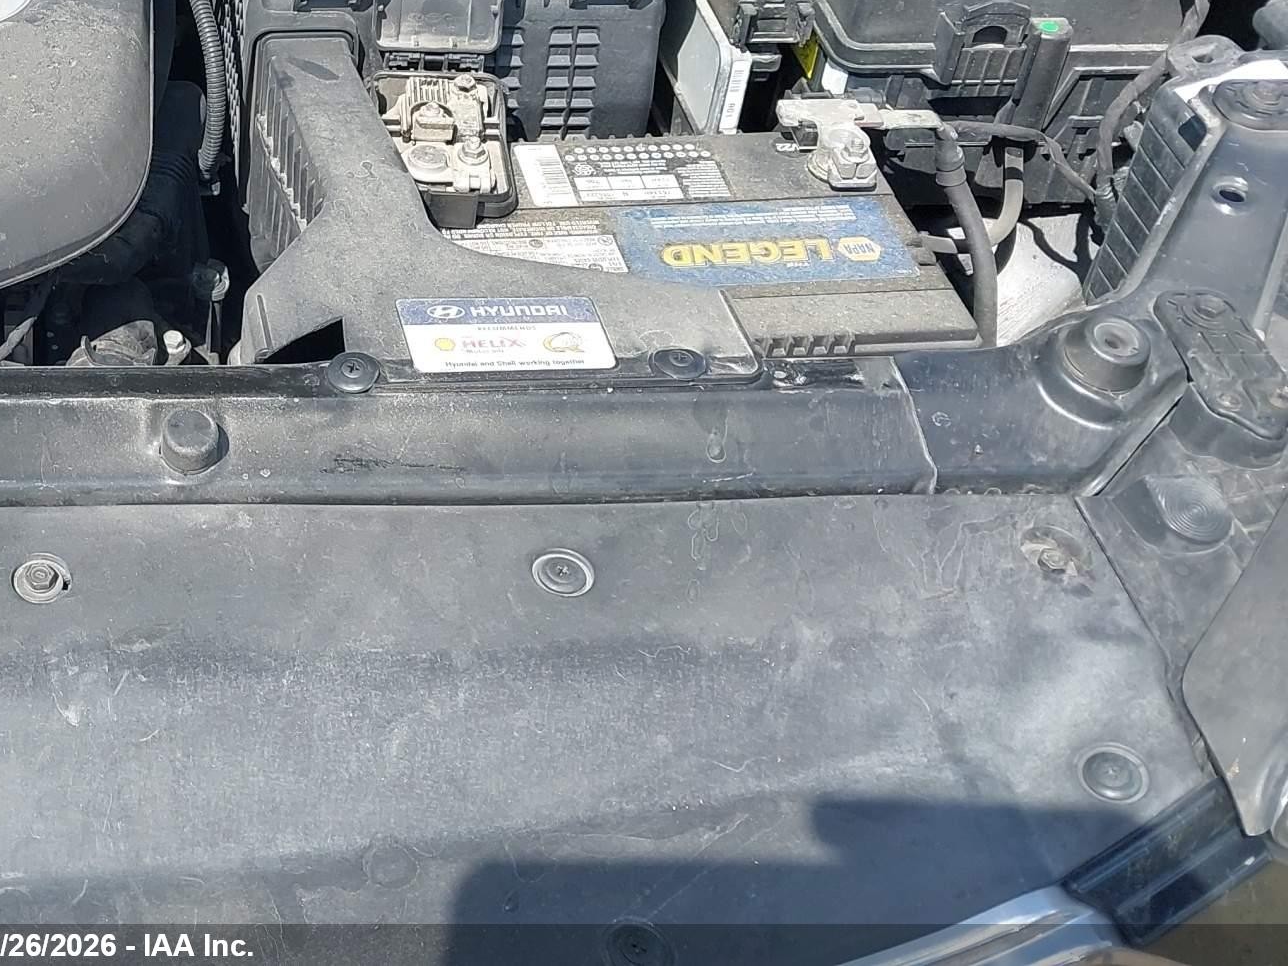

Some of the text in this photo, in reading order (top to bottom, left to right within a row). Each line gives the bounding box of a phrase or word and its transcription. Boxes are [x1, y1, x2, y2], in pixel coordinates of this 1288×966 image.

[661, 237, 834, 269] LEGEND
[844, 242, 875, 255] NAPA
[470, 305, 569, 317] HYUNDAI
